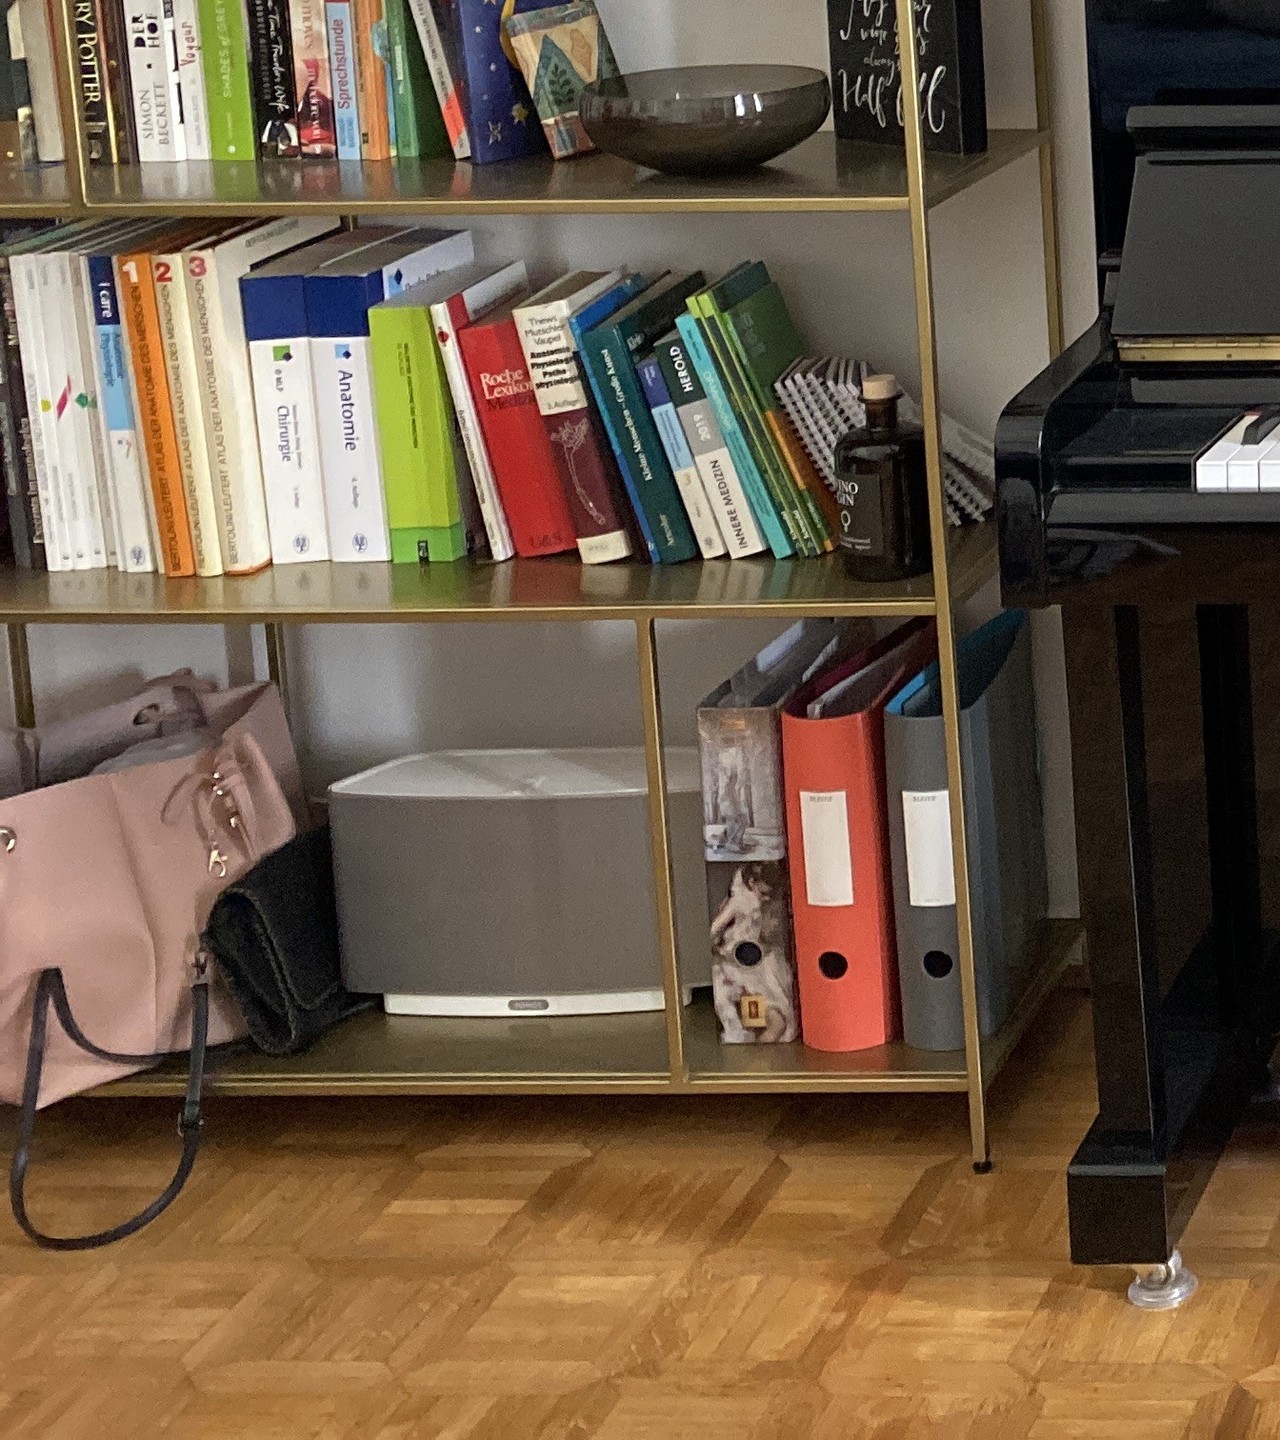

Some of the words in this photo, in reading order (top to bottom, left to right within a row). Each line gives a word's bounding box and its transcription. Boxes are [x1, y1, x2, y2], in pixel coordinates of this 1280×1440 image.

[131, 12, 146, 49] DER
[146, 13, 160, 49] HOF
[77, 33, 102, 106] POTTER
[217, 47, 232, 98] SHADES
[331, 18, 351, 110] Sprechstunde
[138, 88, 151, 140] SIMON
[153, 81, 170, 146] BECKETT
[267, 84, 290, 115] Wife
[837, 68, 890, 128] Half
[311, 120, 323, 140] you
[122, 260, 139, 284] 1
[154, 261, 173, 283] 2
[188, 256, 207, 278] 3
[99, 289, 112, 319] care
[129, 285, 148, 343] MENSCHEN
[159, 283, 177, 341] MENSCHEN
[193, 278, 211, 335] MENSCHEN
[528, 315, 558, 327] Thews
[136, 343, 150, 364] DES
[167, 342, 178, 362] DES
[200, 335, 214, 356] DES
[530, 345, 571, 359] Anatomie
[532, 335, 563, 346] Vaupel
[478, 368, 524, 388] Roche
[600, 348, 615, 376] Kunst
[669, 345, 694, 393] HEROLD
[140, 365, 159, 419] ANATOMIE
[170, 363, 186, 416] ANATOMIE
[204, 357, 220, 410] ANATOMIE
[211, 411, 224, 432] DER
[337, 368, 360, 452] Anatomie
[150, 419, 162, 441] DER
[176, 416, 189, 438] DER
[276, 404, 292, 463] Chirurgie
[622, 409, 645, 457] Menschen
[693, 413, 712, 442] 2019
[153, 441, 167, 473] ATLAS
[180, 439, 193, 471] ATLAS
[214, 433, 228, 465] ATLAS
[635, 451, 653, 482] Kleine
[708, 459, 733, 505] MEDIZIN
[725, 504, 749, 550] INNERE
